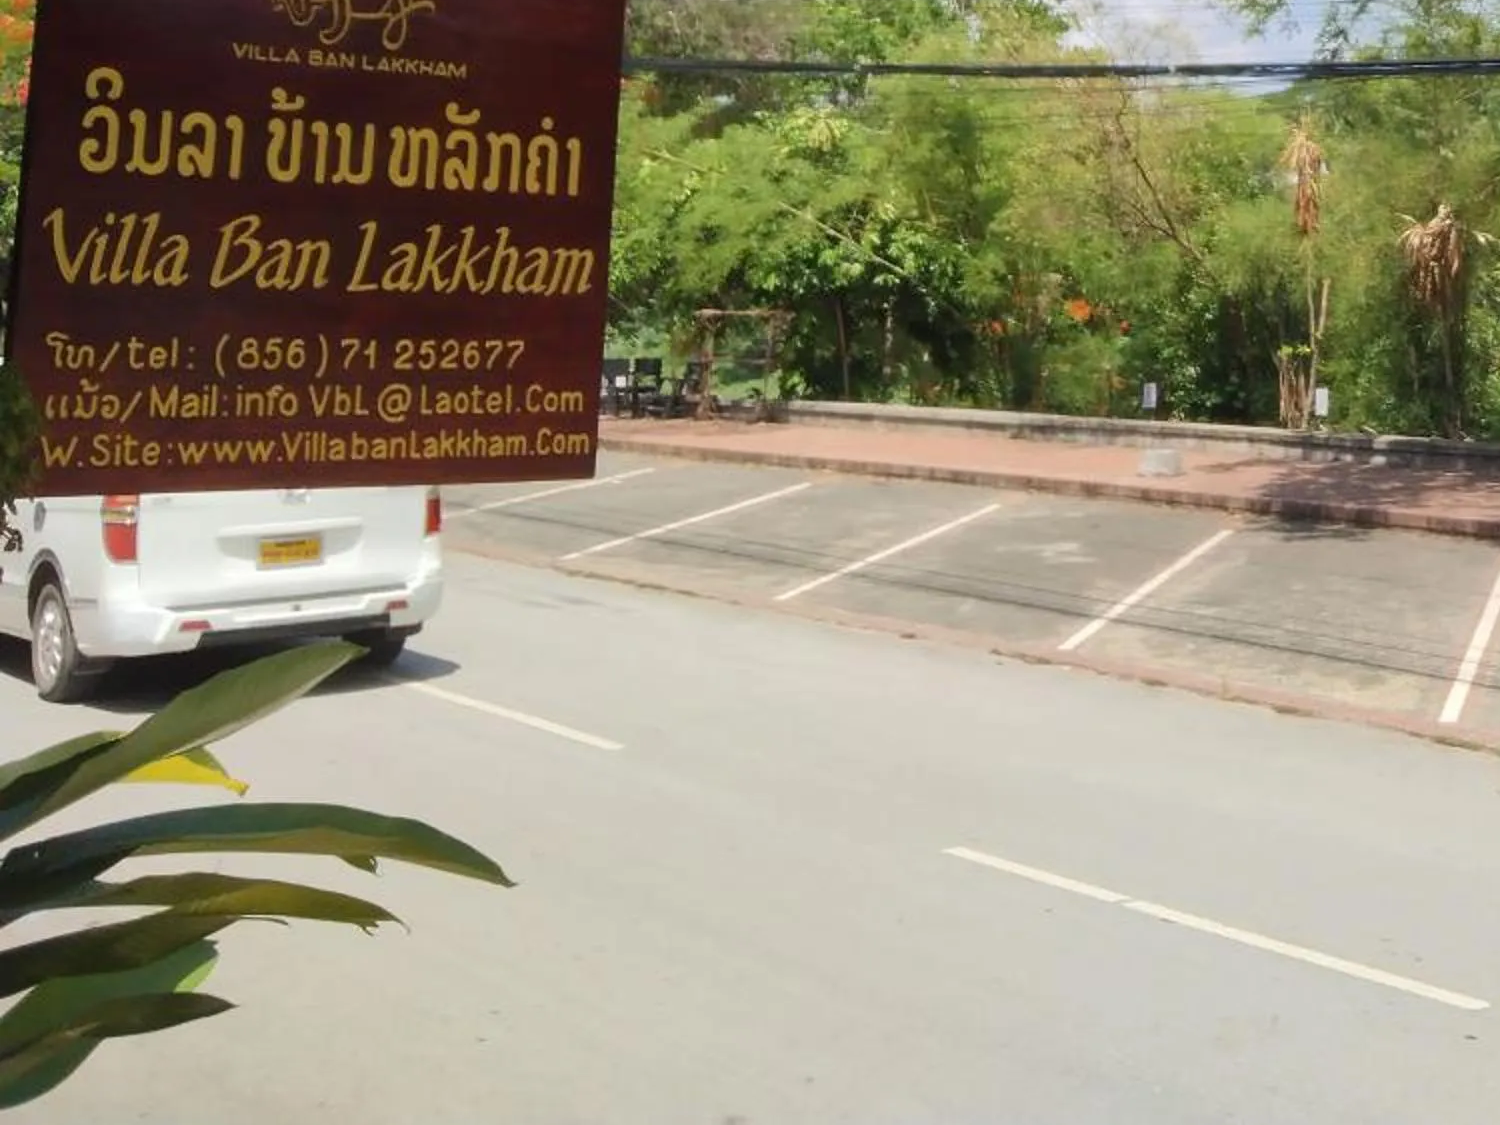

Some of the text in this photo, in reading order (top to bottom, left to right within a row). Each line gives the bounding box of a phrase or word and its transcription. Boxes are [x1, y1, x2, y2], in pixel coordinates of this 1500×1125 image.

[232, 42, 467, 78] VILLA BAN LAKKHAM
[42, 207, 595, 296] Villa Ban Lakkham
[393, 338, 525, 371] 252677
